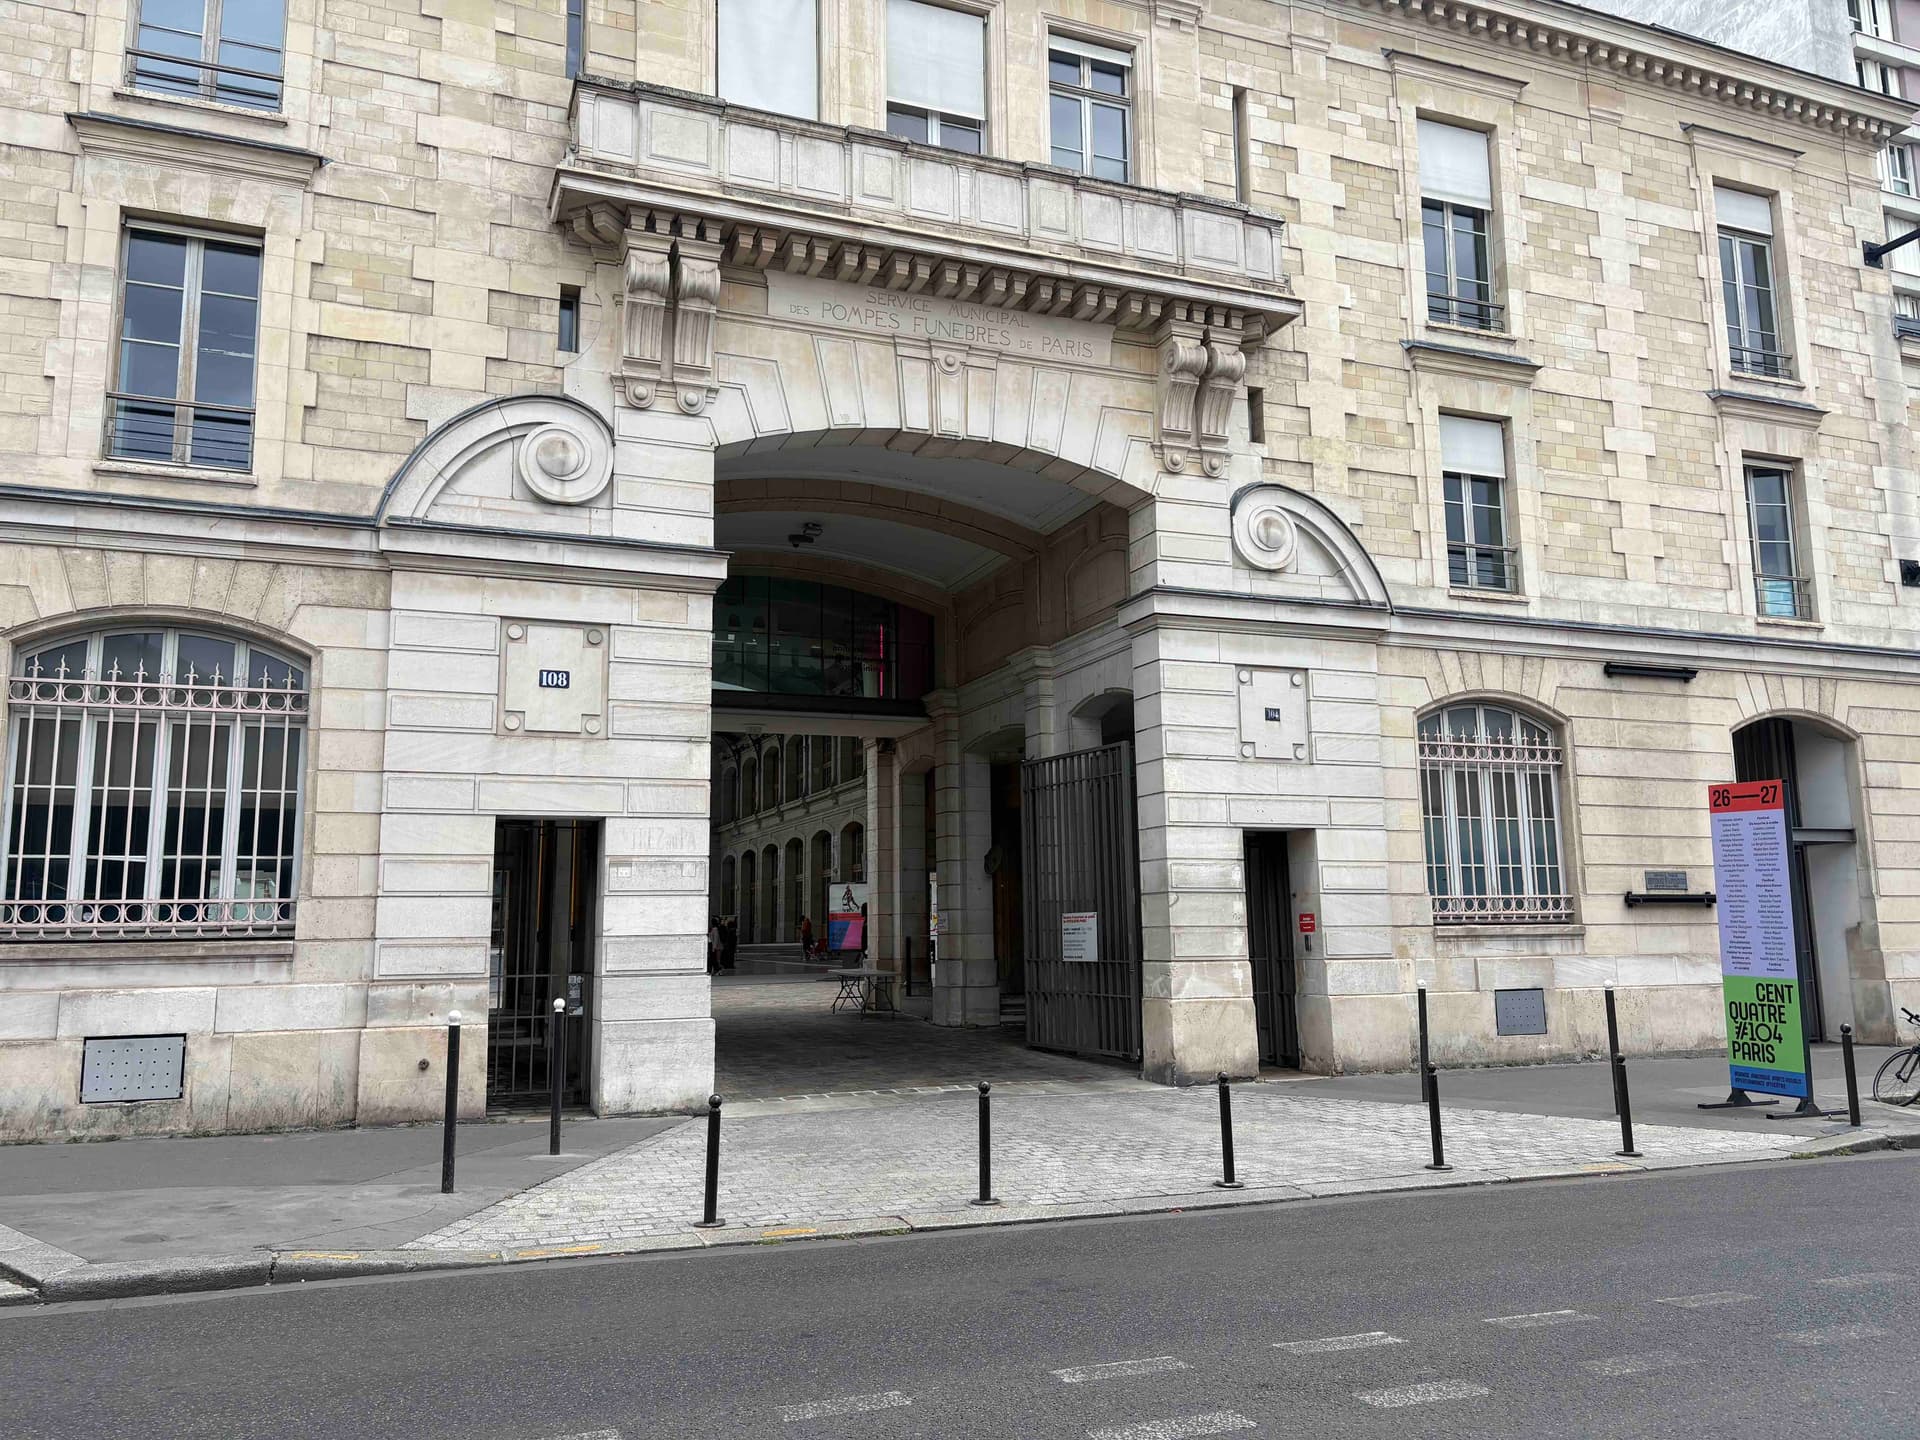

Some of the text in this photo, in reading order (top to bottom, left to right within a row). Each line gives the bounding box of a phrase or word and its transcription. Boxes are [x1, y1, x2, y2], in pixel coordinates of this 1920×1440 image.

[866, 290, 1030, 329] SERVICE MUNICIPAL
[789, 300, 1093, 359] DES POMPES FUNEBRES DE PARIS
[541, 671, 567, 687] 108
[1756, 983, 1793, 1004] CENT
[1729, 1001, 1787, 1024] QUATRE
[1735, 1021, 1783, 1044] #104
[1732, 1041, 1776, 1063] PARIS
